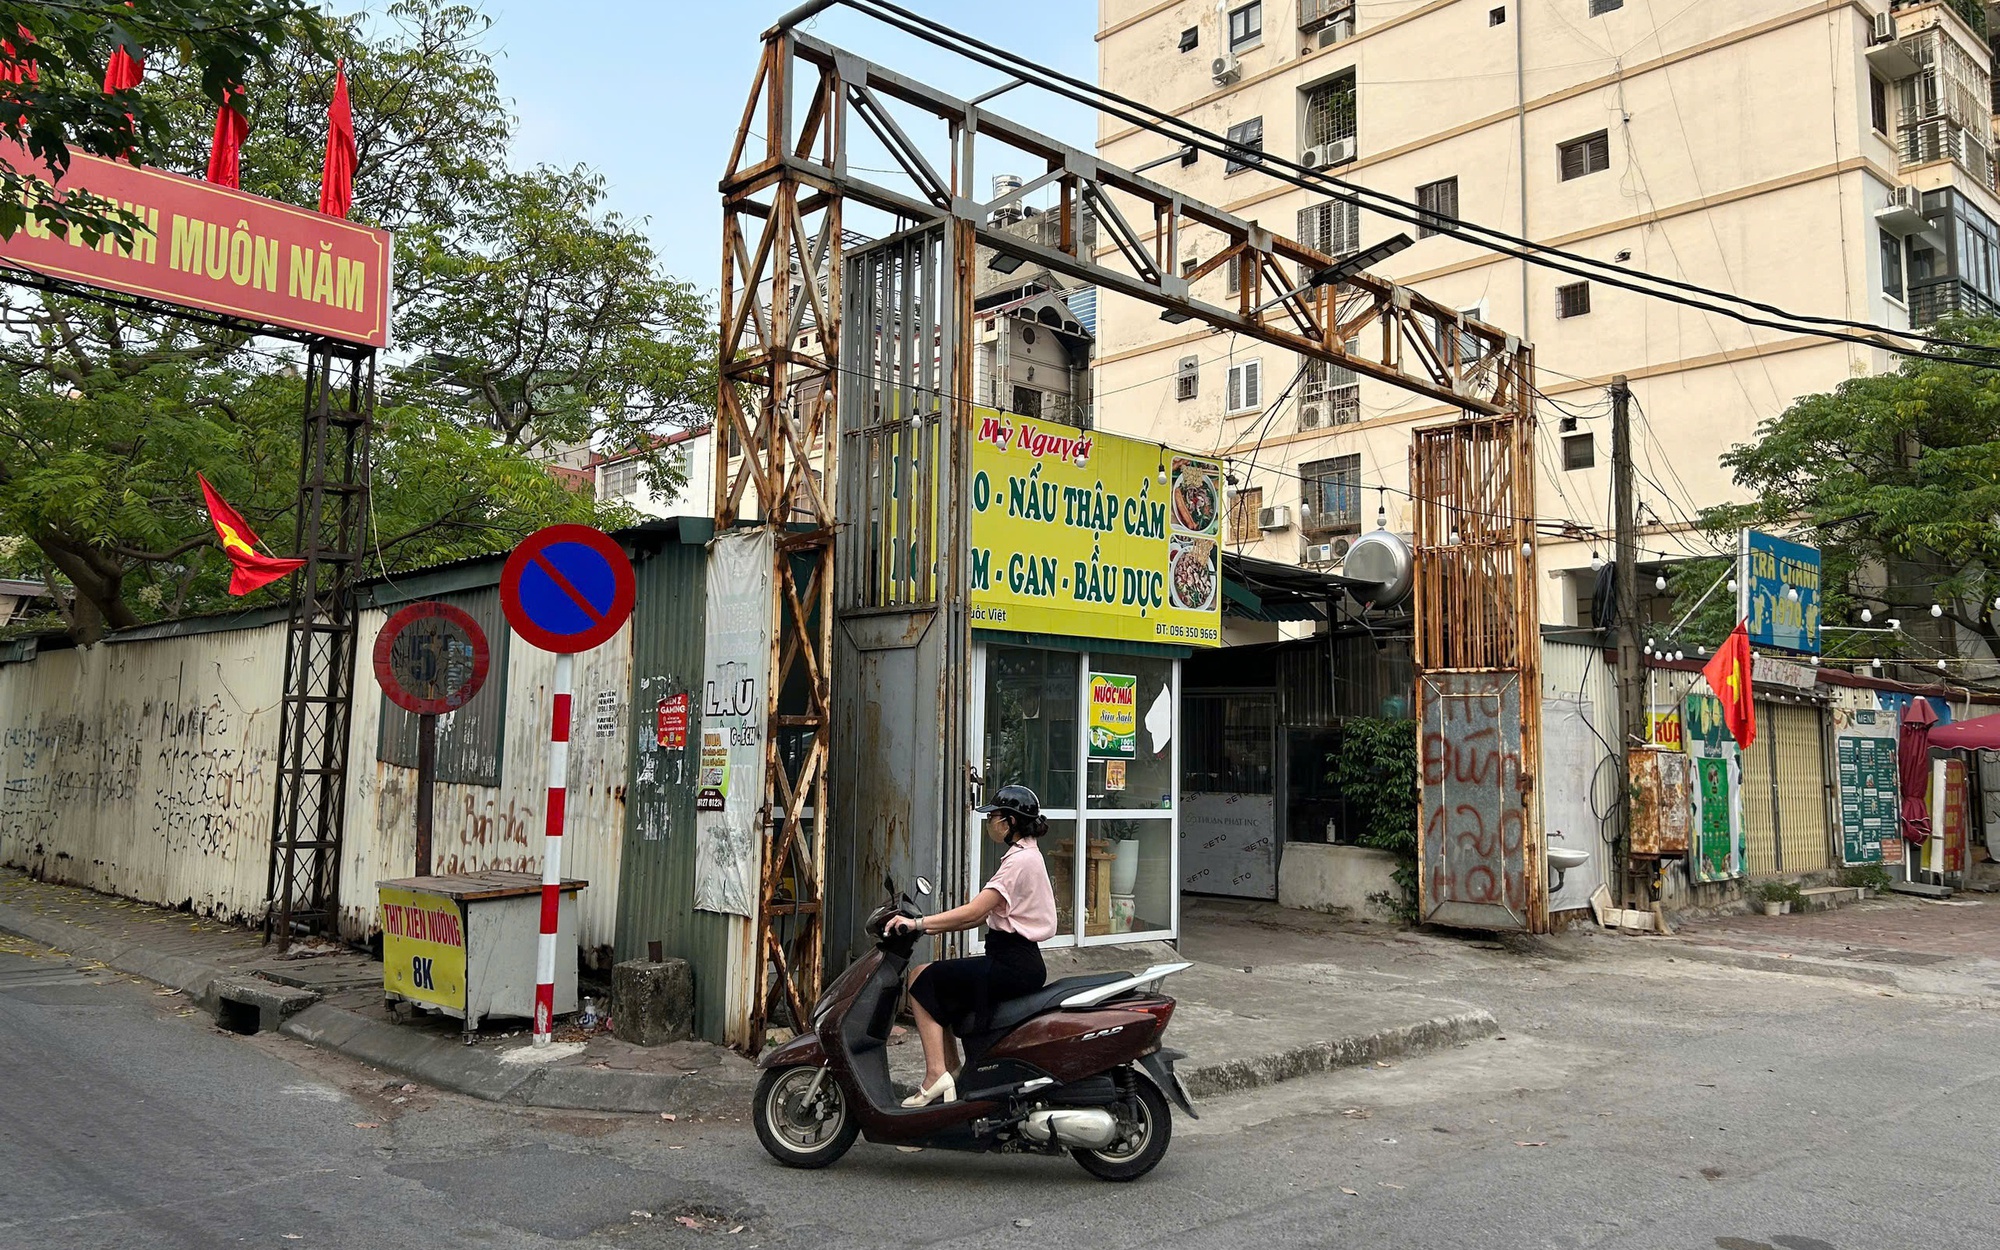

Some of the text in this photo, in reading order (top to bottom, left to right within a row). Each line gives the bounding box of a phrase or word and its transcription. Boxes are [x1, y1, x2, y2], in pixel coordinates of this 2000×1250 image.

[170, 214, 279, 293] MUÔN
[288, 240, 365, 313] NĂM
[1008, 463, 1057, 523] NẤU
[1064, 480, 1119, 541] THẬP
[1123, 477, 1166, 540] CẨM
[1008, 553, 1058, 597] GAN
[1074, 545, 1118, 604] BẦU
[1122, 567, 1163, 617] DỤC
[1750, 544, 1819, 591] TRÀ CHANH
[971, 605, 1006, 623] uốc Việt
[1770, 595, 1802, 629] 1970
[1156, 623, 1217, 640] ĐT: 096 350 9669
[660, 705, 686, 714] GAMING
[1093, 681, 1117, 704] NƯỚC
[1857, 714, 1876, 724] MENU
[1427, 803, 1523, 858] 120
[384, 903, 403, 942] THỊT
[427, 906, 462, 947] NƯỚNG
[412, 956, 435, 991] 8K
